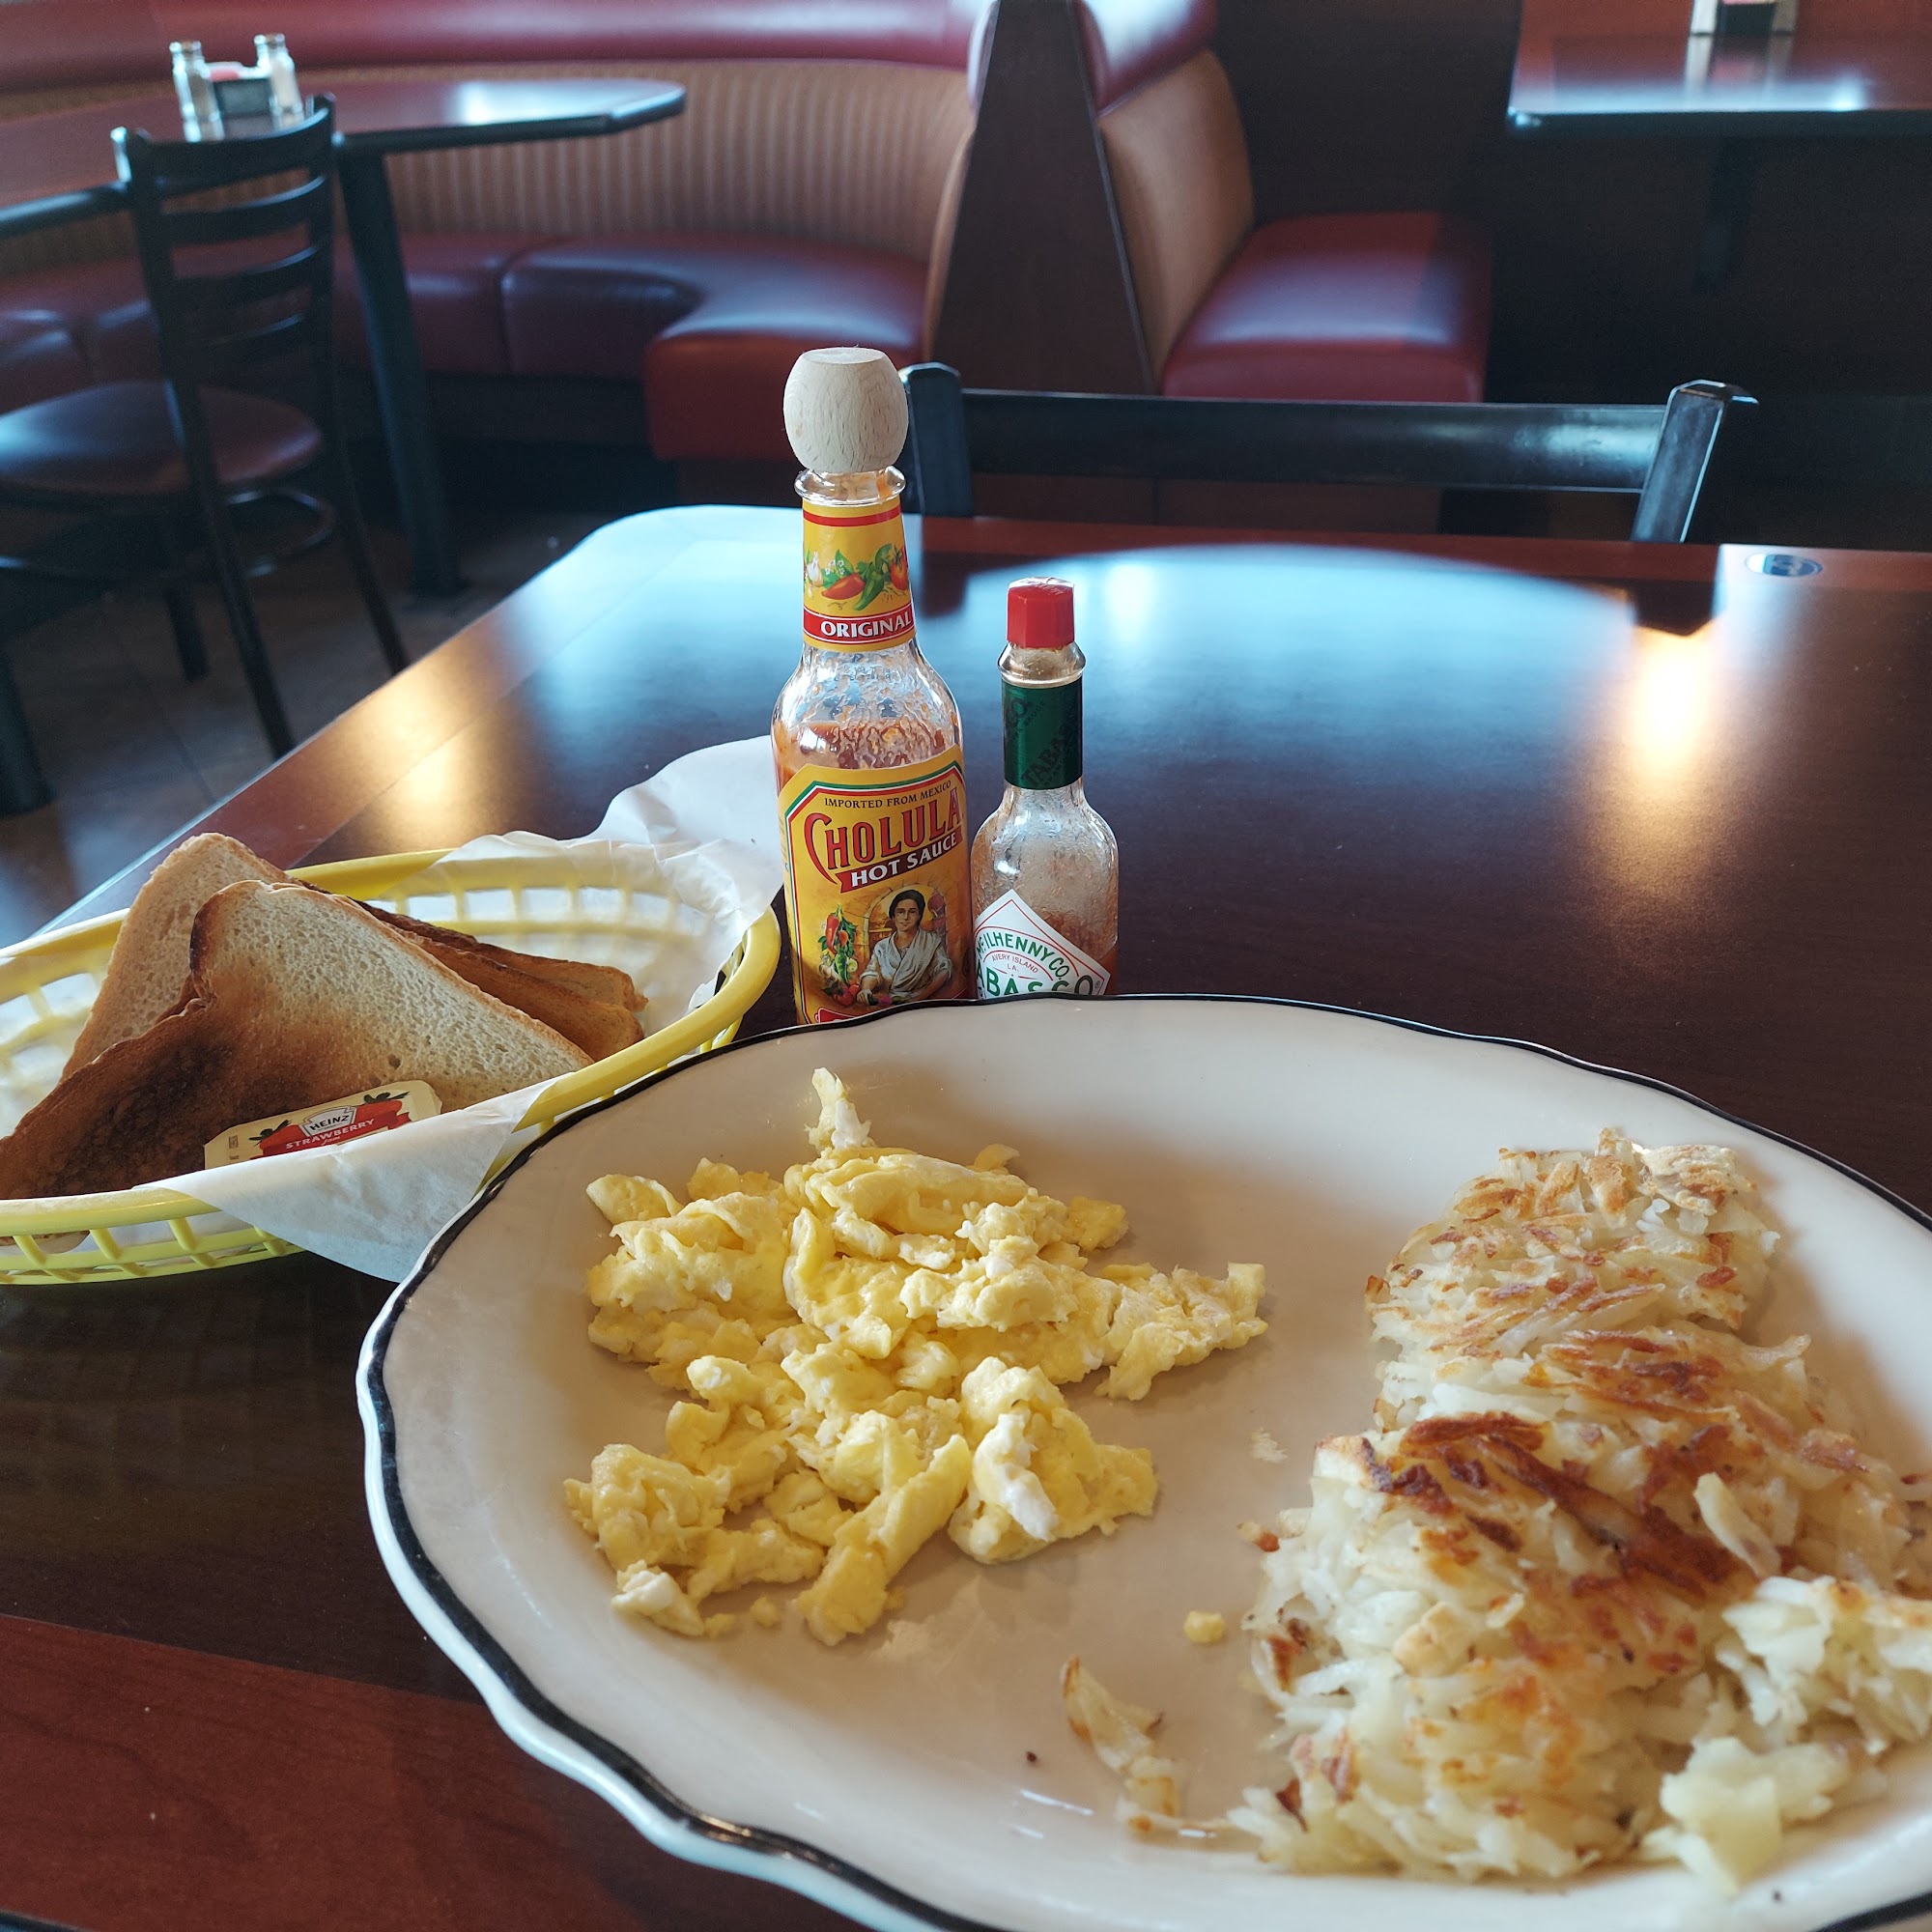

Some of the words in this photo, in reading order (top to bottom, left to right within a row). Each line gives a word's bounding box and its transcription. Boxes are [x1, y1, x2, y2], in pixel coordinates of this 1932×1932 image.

[820, 611, 911, 638] ORIGINAL
[824, 797, 883, 809] IMPORTED
[887, 795, 918, 808] FROM
[920, 780, 952, 801] MEXICO
[804, 786, 962, 885] CHOLULA
[851, 859, 900, 888] HOT
[906, 832, 957, 869] SAUCE
[991, 953, 1010, 962] AVERY
[1011, 955, 1038, 974] ISLAND
[286, 1118, 375, 1150] STRAWBERRY
[310, 1115, 349, 1131] HEINZ
